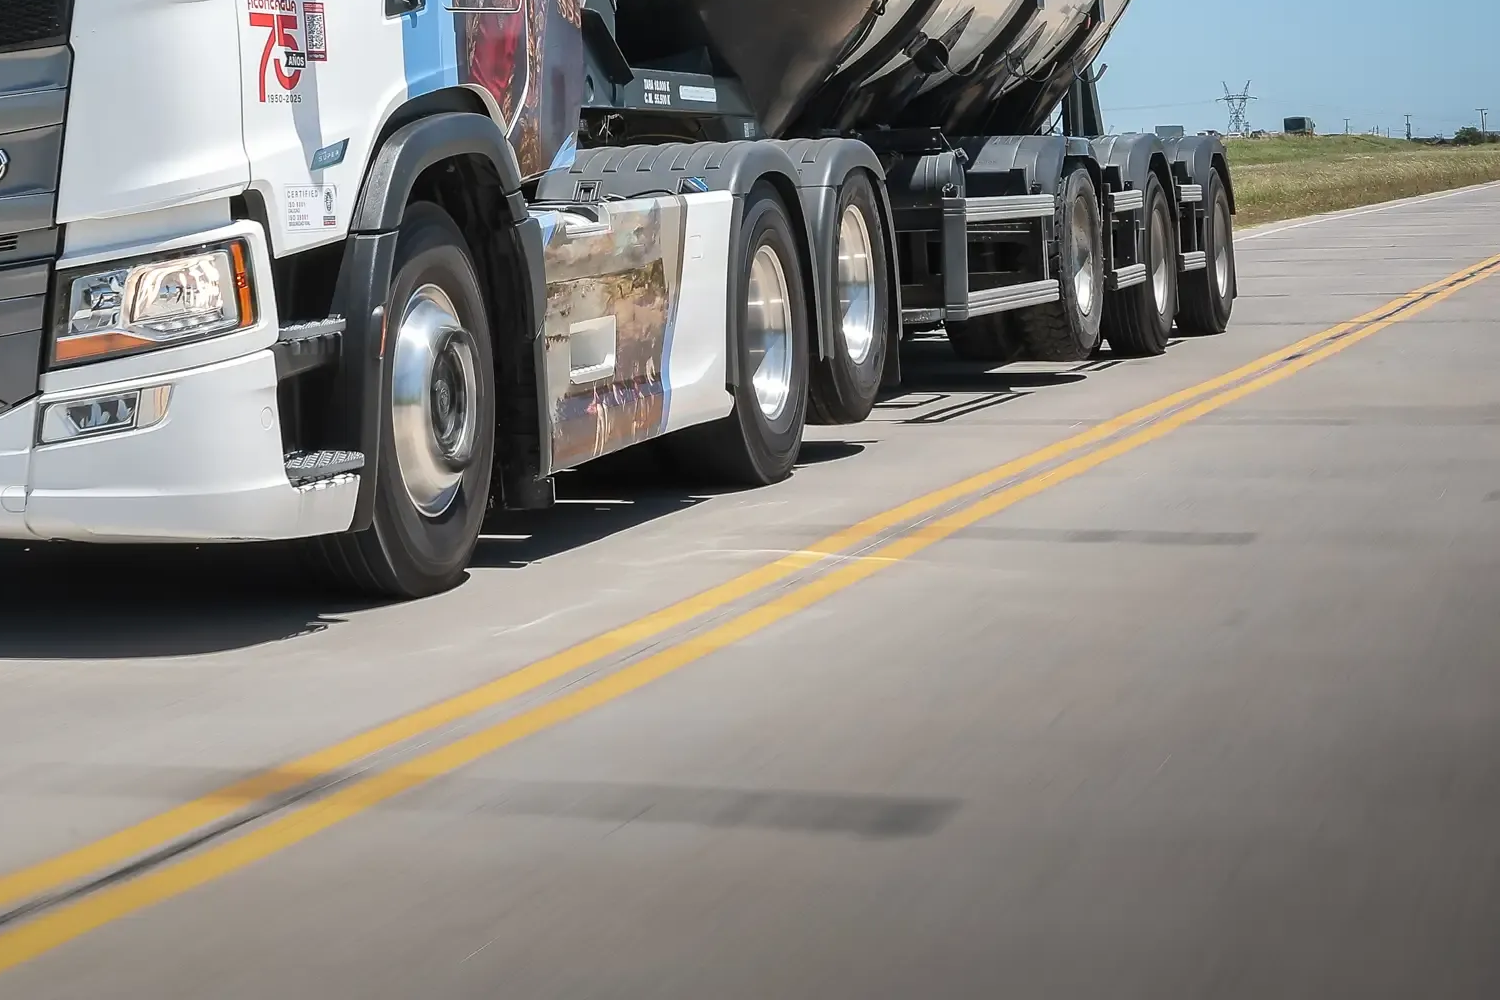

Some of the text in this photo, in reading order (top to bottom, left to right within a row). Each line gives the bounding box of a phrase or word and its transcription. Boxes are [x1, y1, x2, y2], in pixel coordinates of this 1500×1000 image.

[248, 12, 302, 102] 75
[288, 53, 305, 67] AÑOS
[267, 94, 302, 104] 1950-2025
[318, 149, 339, 162] SUPER
[287, 189, 319, 199] CERTIFIED
